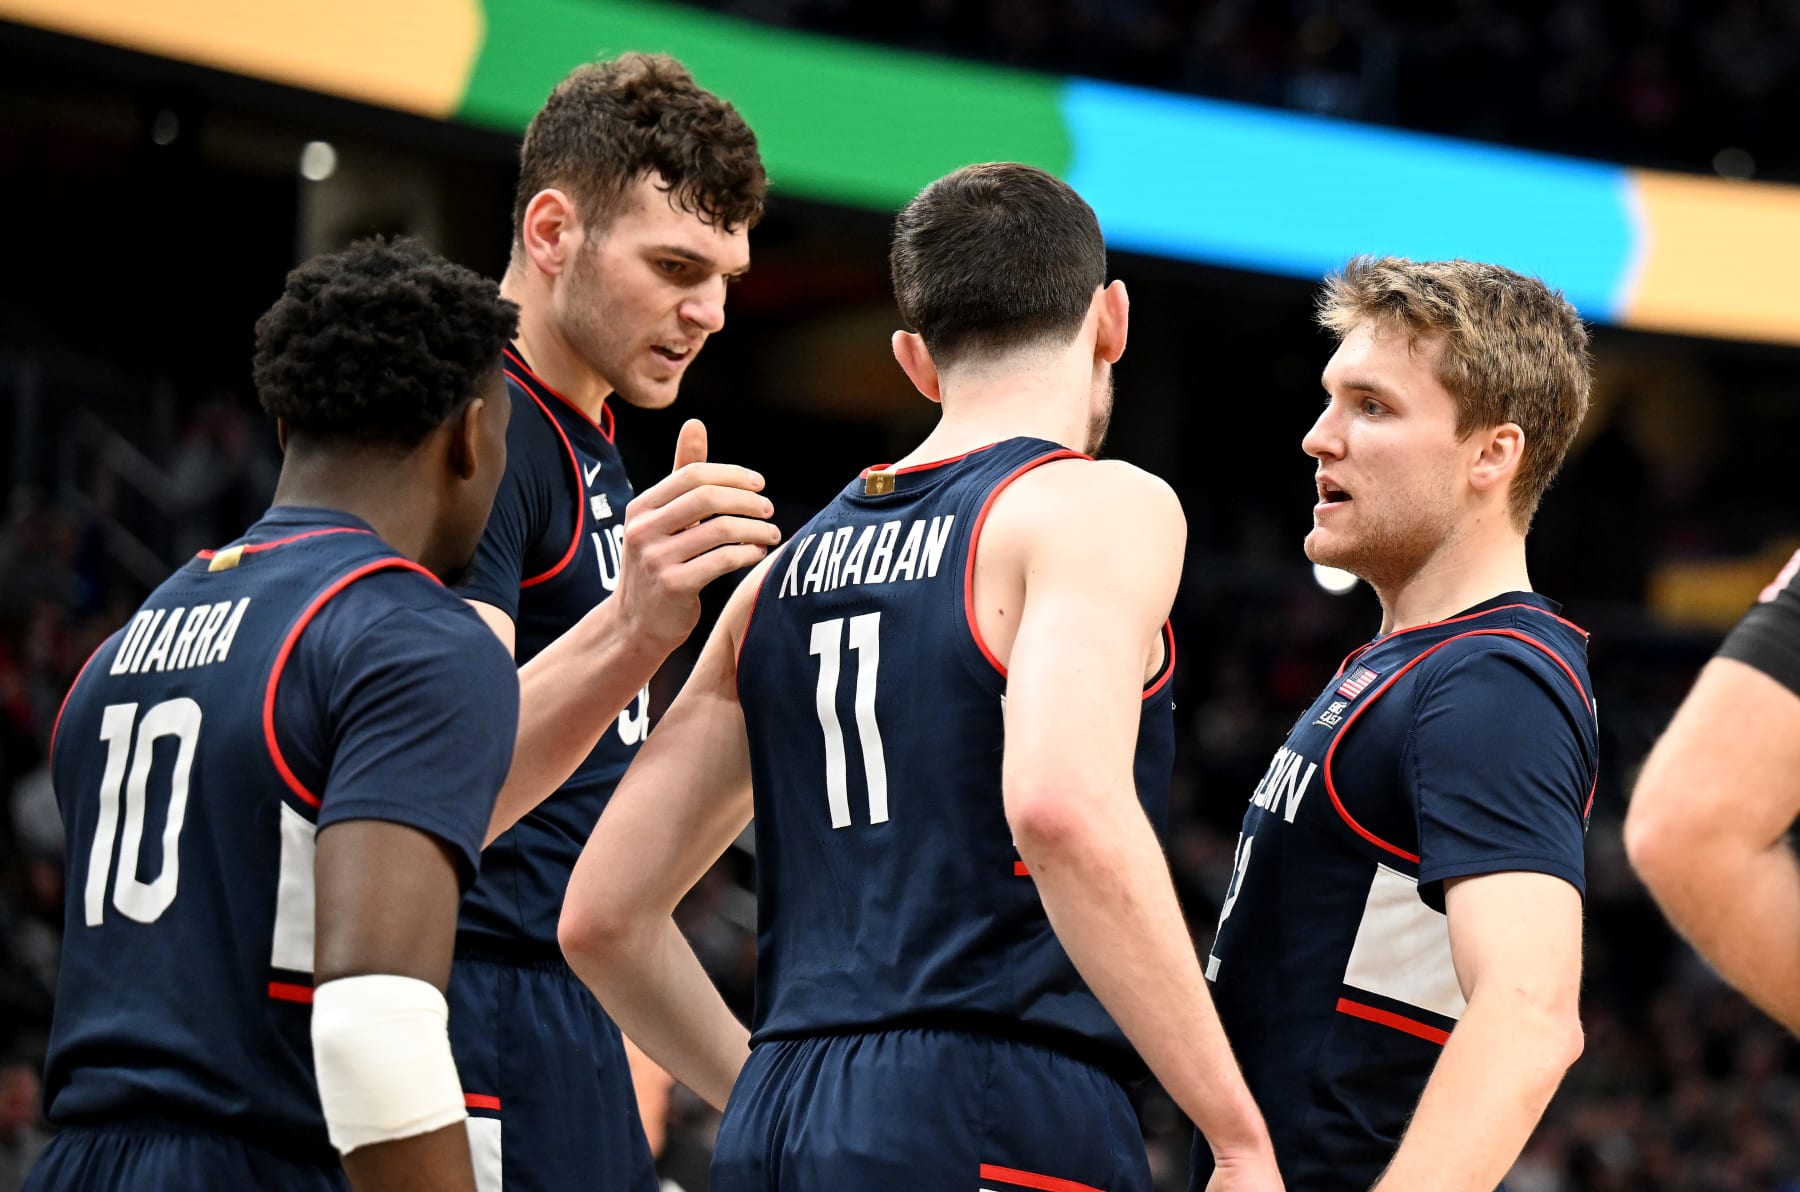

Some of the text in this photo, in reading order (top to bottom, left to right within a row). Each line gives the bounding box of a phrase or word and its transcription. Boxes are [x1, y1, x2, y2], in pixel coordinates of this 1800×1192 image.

[778, 514, 955, 599] KARABAN
[109, 597, 251, 675] DIARRA
[809, 611, 889, 829] 11
[84, 697, 202, 927] 10
